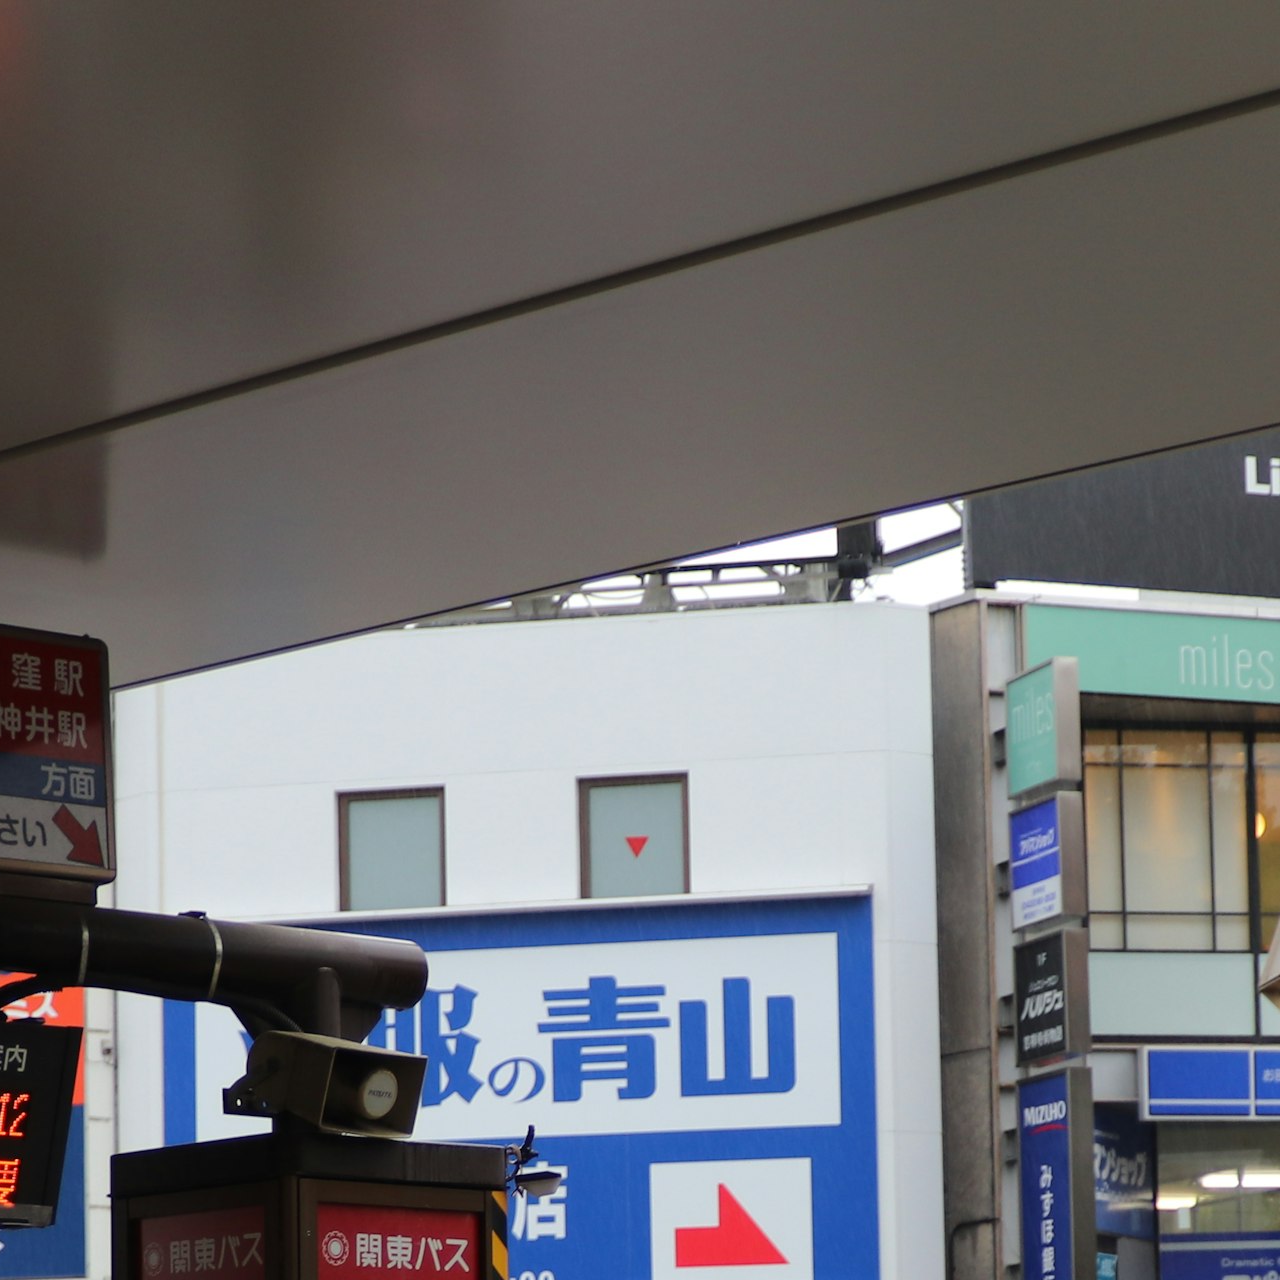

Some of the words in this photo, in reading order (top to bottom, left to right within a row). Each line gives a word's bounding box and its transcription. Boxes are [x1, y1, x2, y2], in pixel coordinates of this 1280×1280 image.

[1179, 633, 1274, 690] miles
[1011, 692, 1054, 743] miles
[41, 762, 96, 799] 方面
[1024, 1100, 1066, 1127] MIZUHO
[170, 1232, 263, 1274] 関東バス
[356, 1233, 469, 1273] 関東バス
